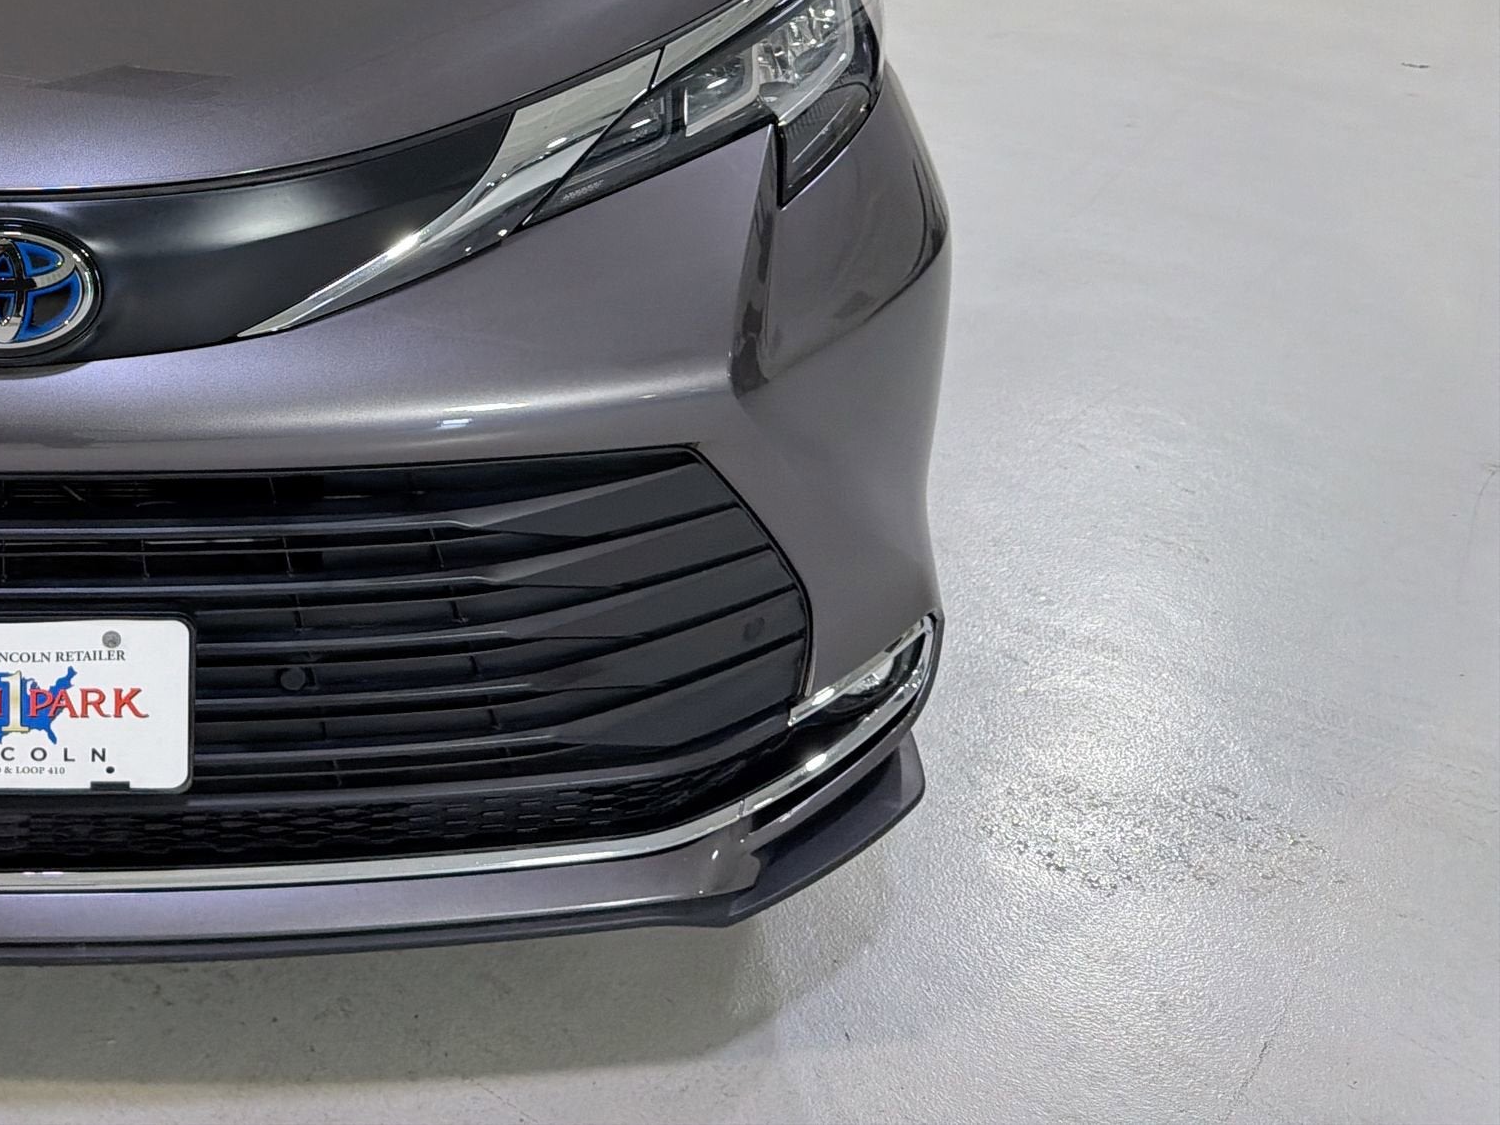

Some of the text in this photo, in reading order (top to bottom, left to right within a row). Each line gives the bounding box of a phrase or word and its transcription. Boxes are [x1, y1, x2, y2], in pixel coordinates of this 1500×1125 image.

[55, 649, 126, 663] RETAILER
[28, 687, 149, 719] PARK
[4, 766, 13, 775] &
[15, 766, 45, 775] LOOP
[48, 766, 66, 775] 410
